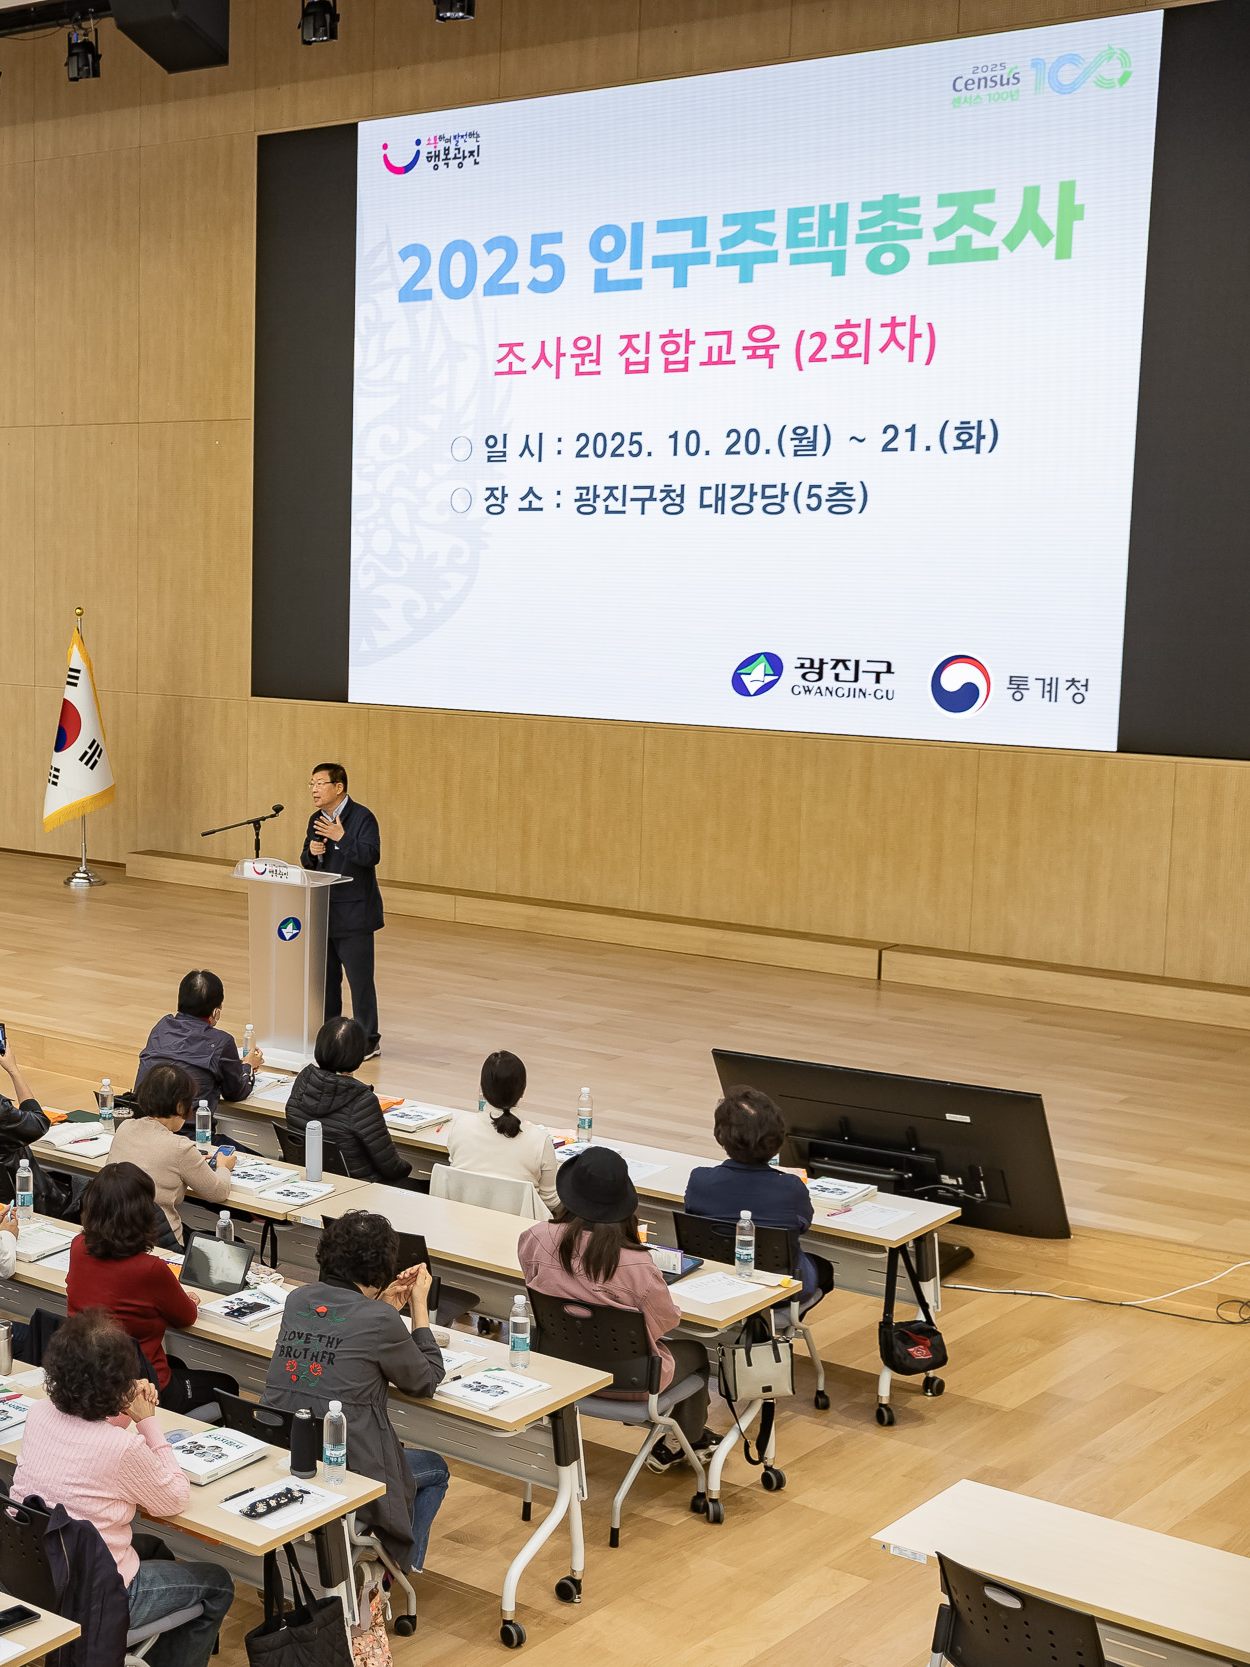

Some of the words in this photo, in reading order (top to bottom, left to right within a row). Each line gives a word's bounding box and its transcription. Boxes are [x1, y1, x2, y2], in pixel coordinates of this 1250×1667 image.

[952, 67, 1021, 93] Census
[972, 62, 1007, 75] 2025
[951, 92, 983, 109] 센서스
[987, 89, 1020, 103] 100년
[426, 145, 481, 171] 행복광진
[398, 231, 566, 303] 2025
[588, 179, 1085, 294] 인구주택총조사
[494, 333, 602, 379] 조사원
[618, 324, 780, 376] 집합교육
[794, 314, 937, 372] (2회차)
[574, 431, 653, 459] 2025.
[668, 430, 711, 457] 10.
[725, 424, 833, 457] 20.(월)
[881, 419, 1000, 455] 21.(화)
[573, 483, 686, 516] 광진구청
[698, 480, 870, 516] 대강당(5층)
[794, 657, 896, 685] 광진구
[791, 684, 895, 701] GWANGJIN-GU
[1007, 675, 1090, 705] 통계청
[283, 1331, 313, 1344] LOVE
[317, 1334, 343, 1350] THY
